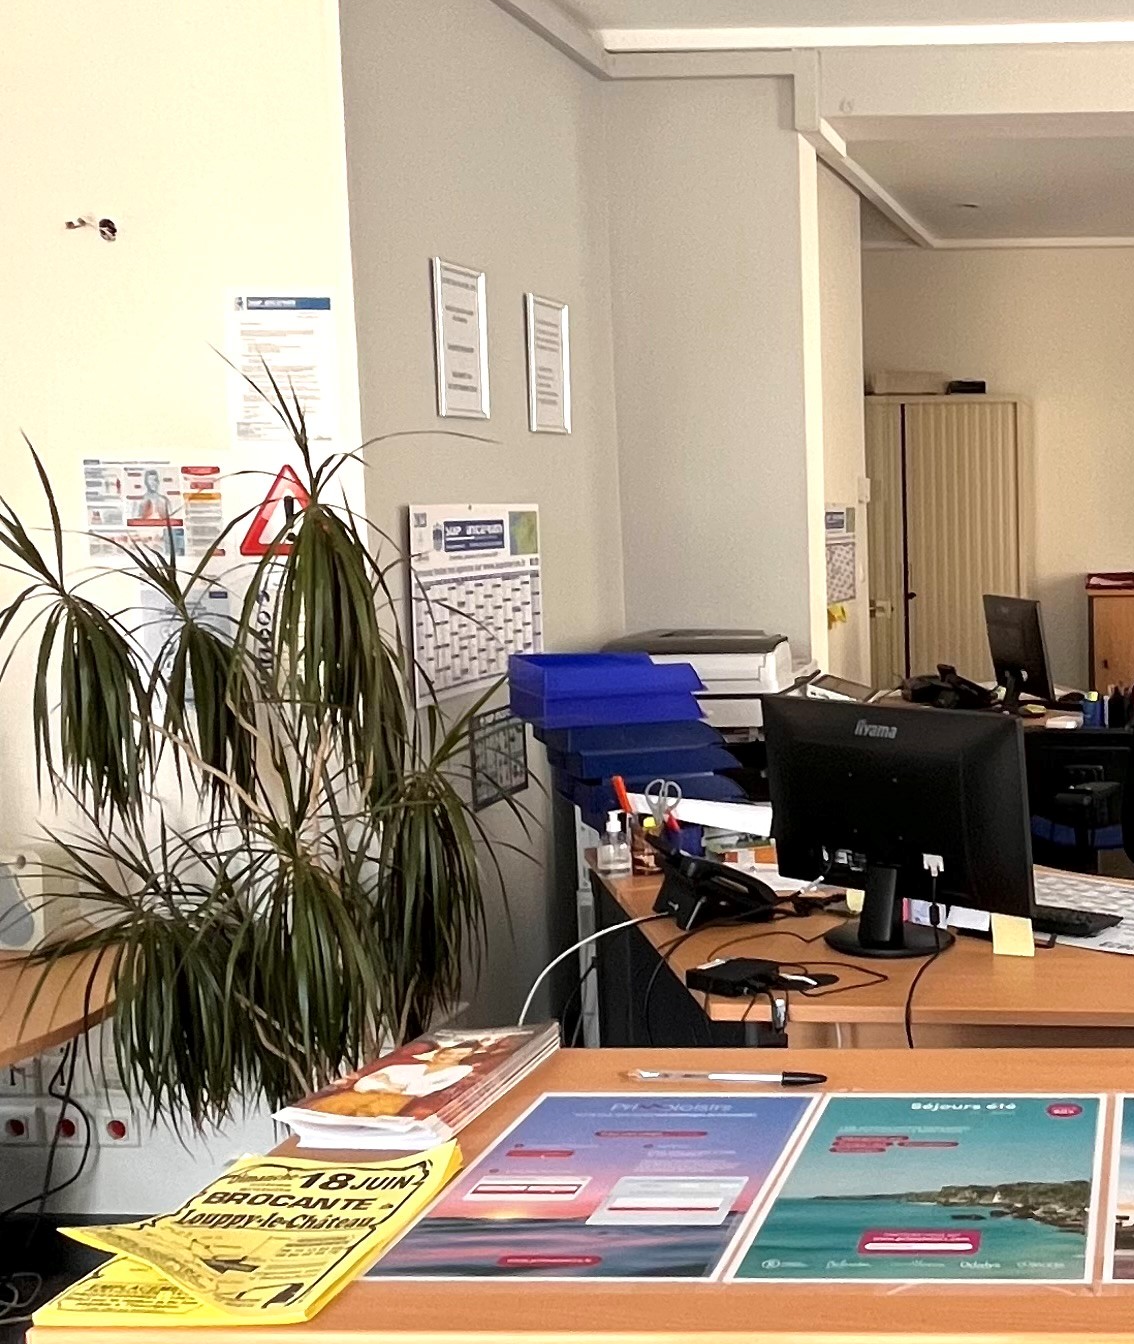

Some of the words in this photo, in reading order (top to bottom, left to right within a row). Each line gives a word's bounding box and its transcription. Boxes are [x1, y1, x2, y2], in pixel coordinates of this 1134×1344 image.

[299, 1172, 356, 1191] 18
[349, 1174, 416, 1191] JUIN
[201, 1191, 378, 1211] BROCANTE
